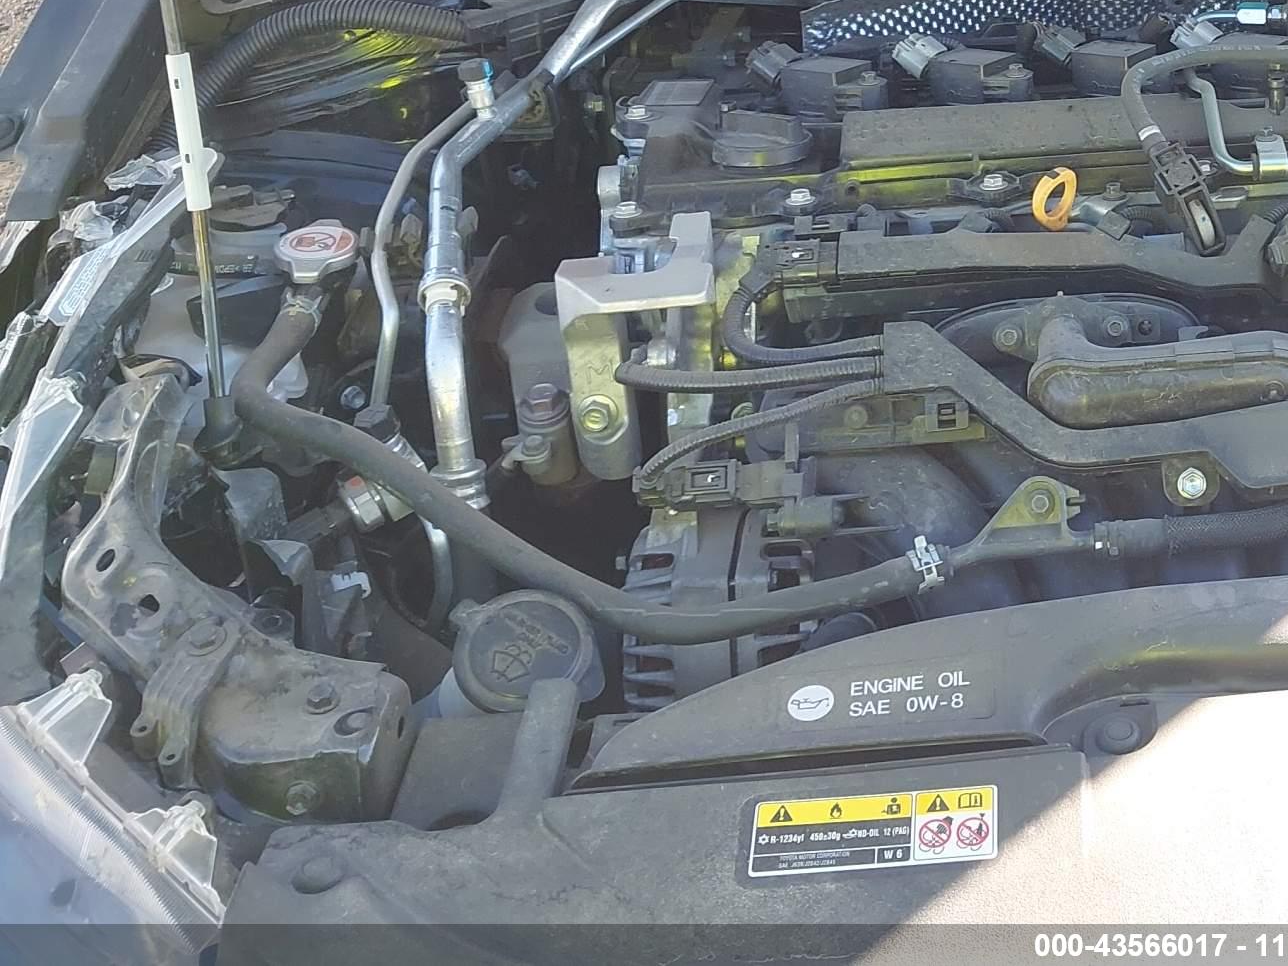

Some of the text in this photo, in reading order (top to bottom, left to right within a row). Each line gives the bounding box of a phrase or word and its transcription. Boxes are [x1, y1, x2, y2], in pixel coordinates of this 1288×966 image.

[850, 671, 970, 696] ENGINE OIL
[849, 692, 964, 717] SAE 0W-8
[884, 827, 891, 837] 12
